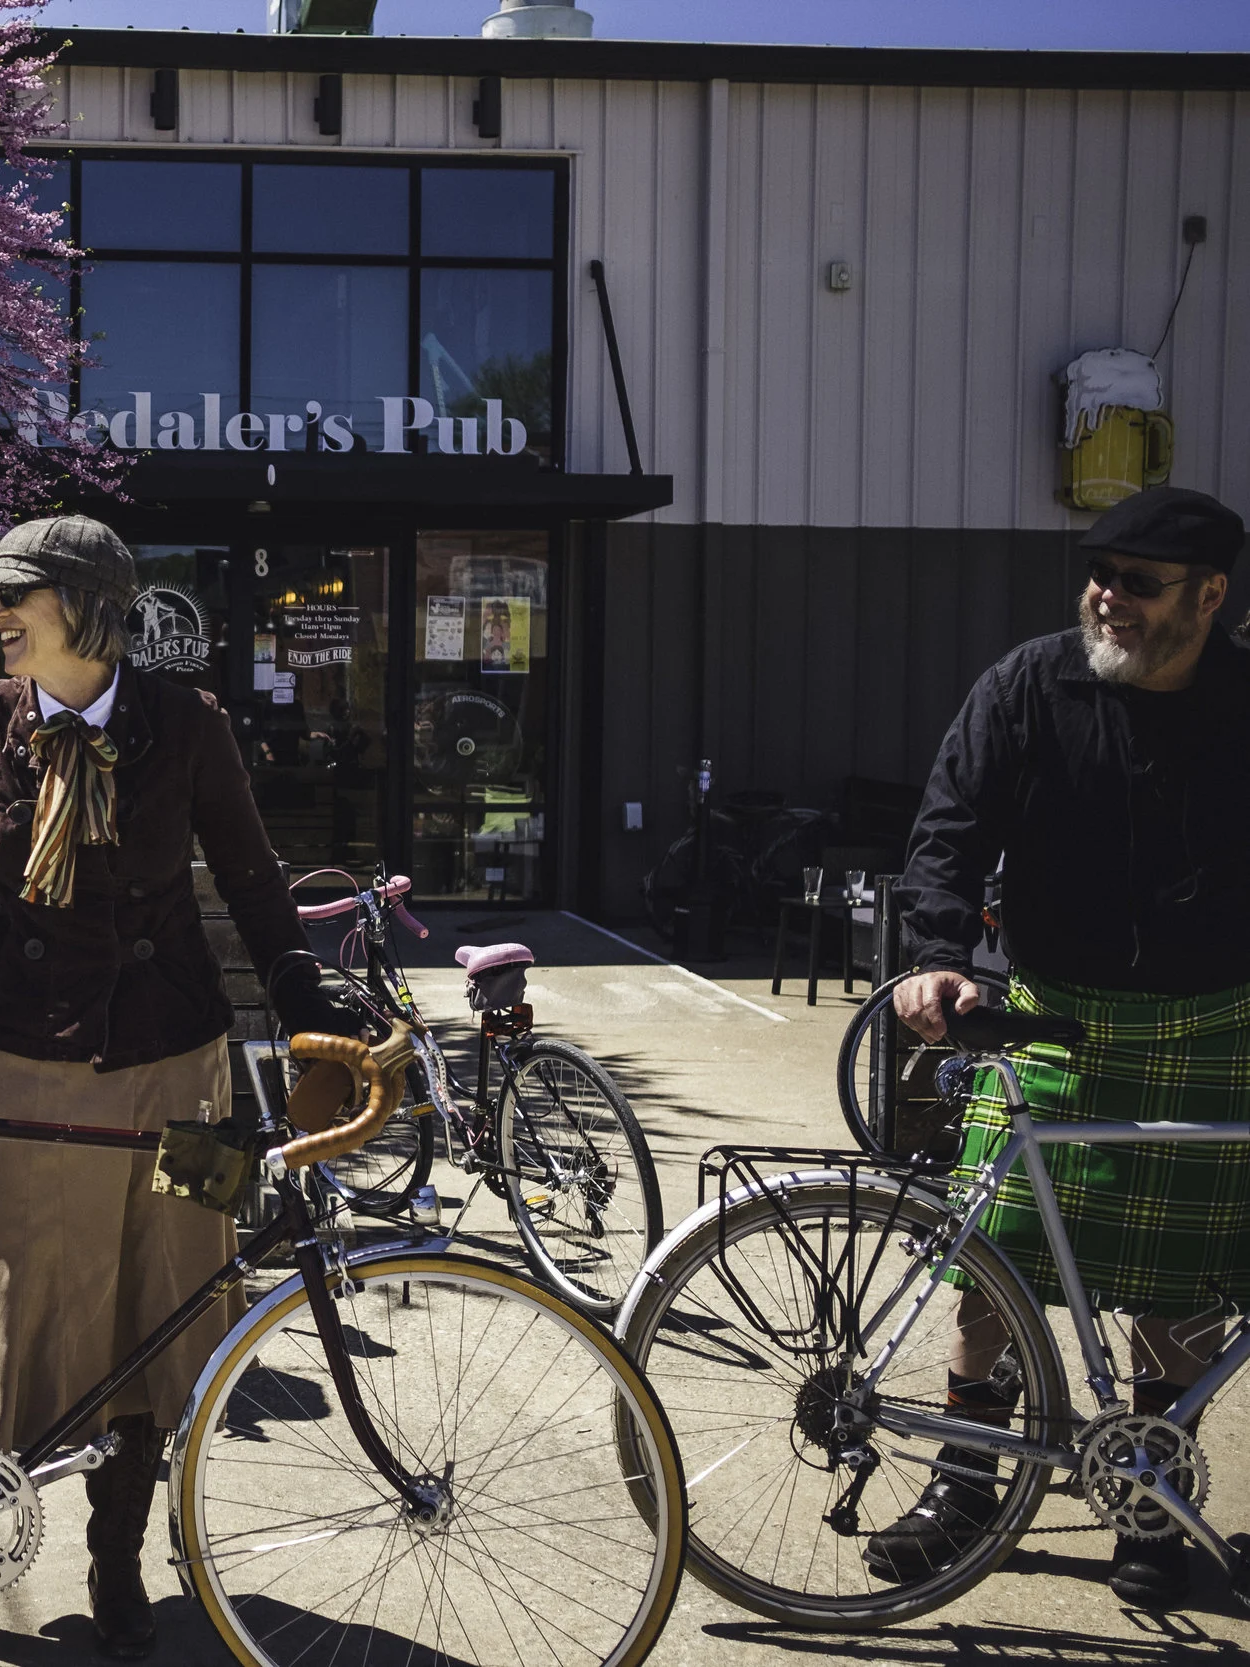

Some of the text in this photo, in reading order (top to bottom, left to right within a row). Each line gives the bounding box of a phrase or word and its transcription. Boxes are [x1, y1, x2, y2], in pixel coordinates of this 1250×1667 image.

[17, 390, 528, 456] Pedaler's Pub
[255, 549, 269, 576] 8
[306, 604, 337, 612] HOURS
[283, 614, 360, 624] Tuesday thru Sunday
[320, 632, 350, 640] Mondays
[127, 637, 210, 667] DALER'S PUB
[288, 648, 352, 664] ENJOY THE RIDE
